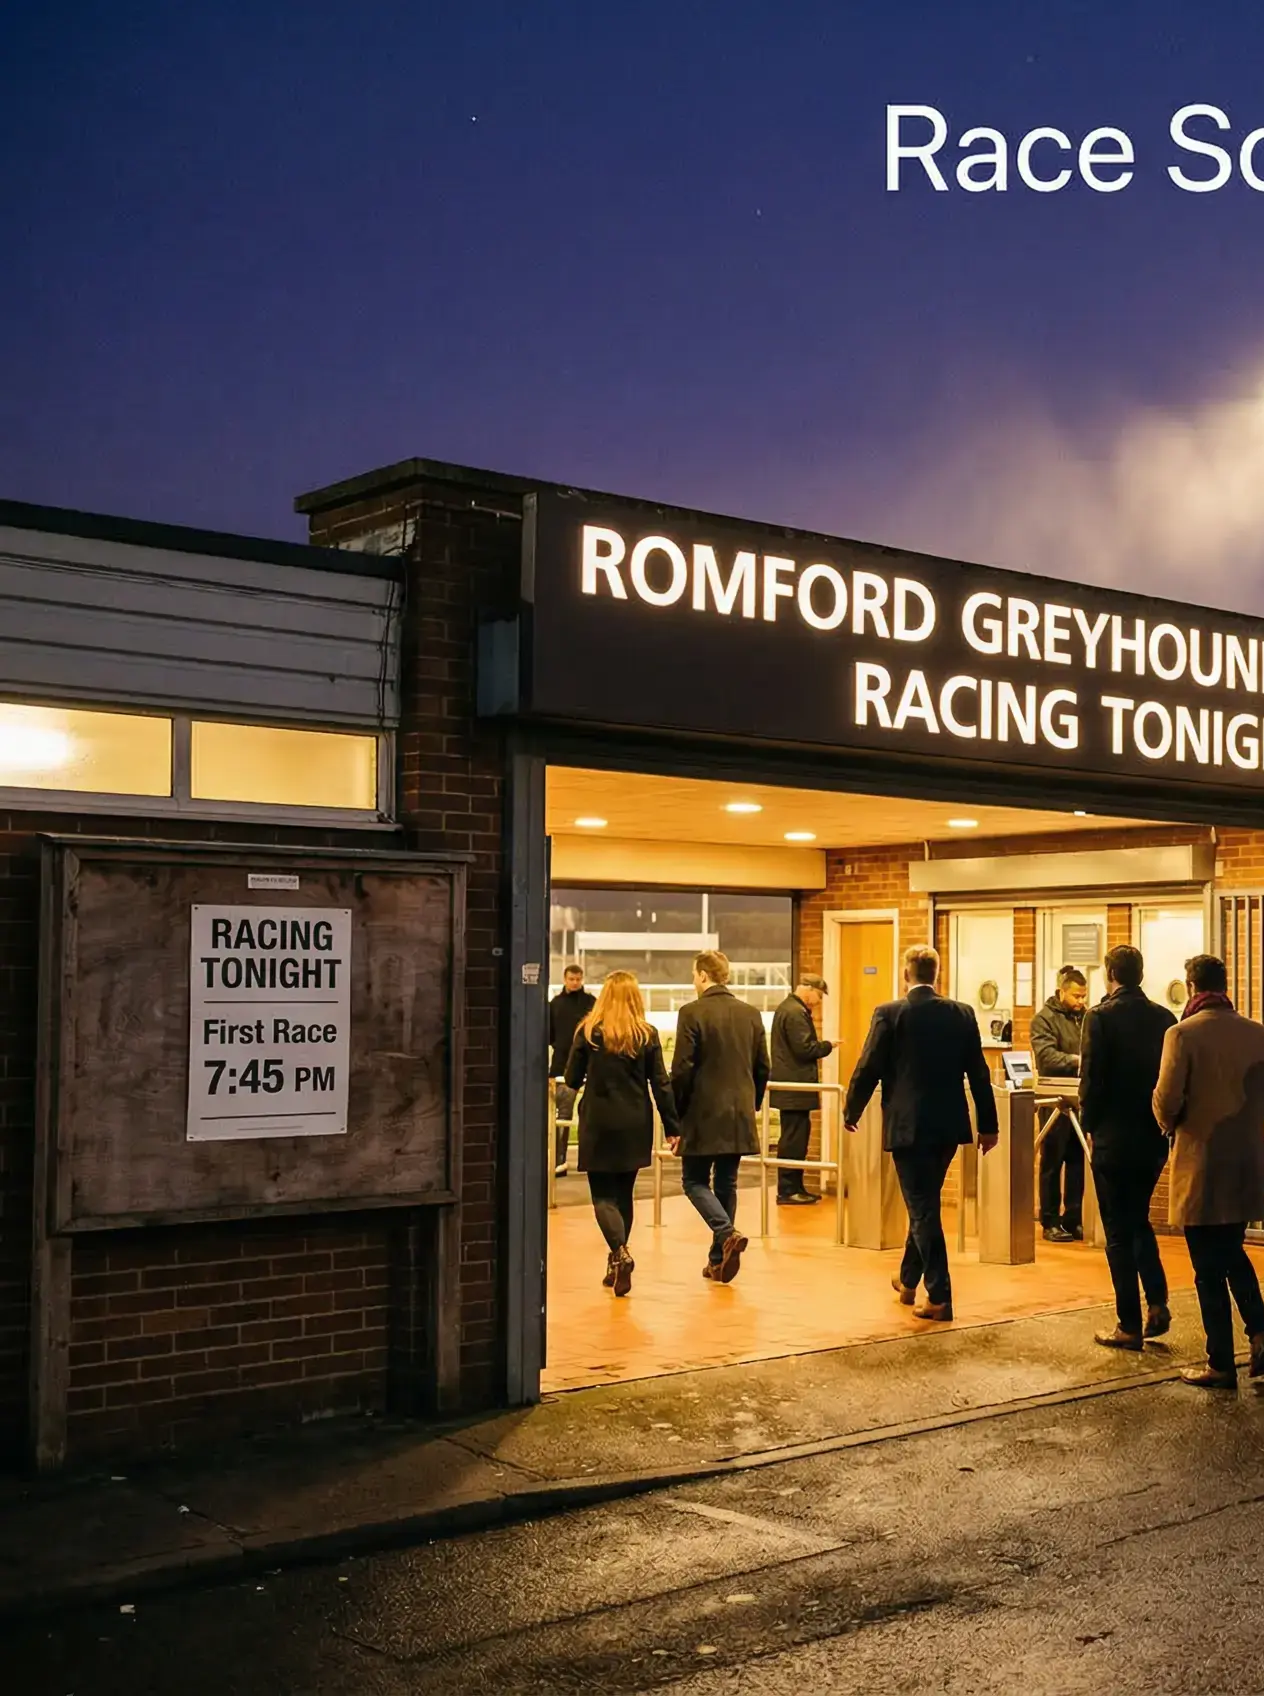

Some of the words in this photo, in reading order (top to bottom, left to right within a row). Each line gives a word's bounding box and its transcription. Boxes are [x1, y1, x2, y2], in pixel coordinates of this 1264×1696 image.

[582, 525, 936, 642] ROMFORD
[854, 661, 1079, 750] RACING
[211, 918, 333, 951] RACING
[200, 957, 342, 989] TONIGHT
[203, 1019, 265, 1045] First
[273, 1018, 337, 1044] Race
[204, 1058, 284, 1095] 7:45
[294, 1066, 335, 1092] PM
